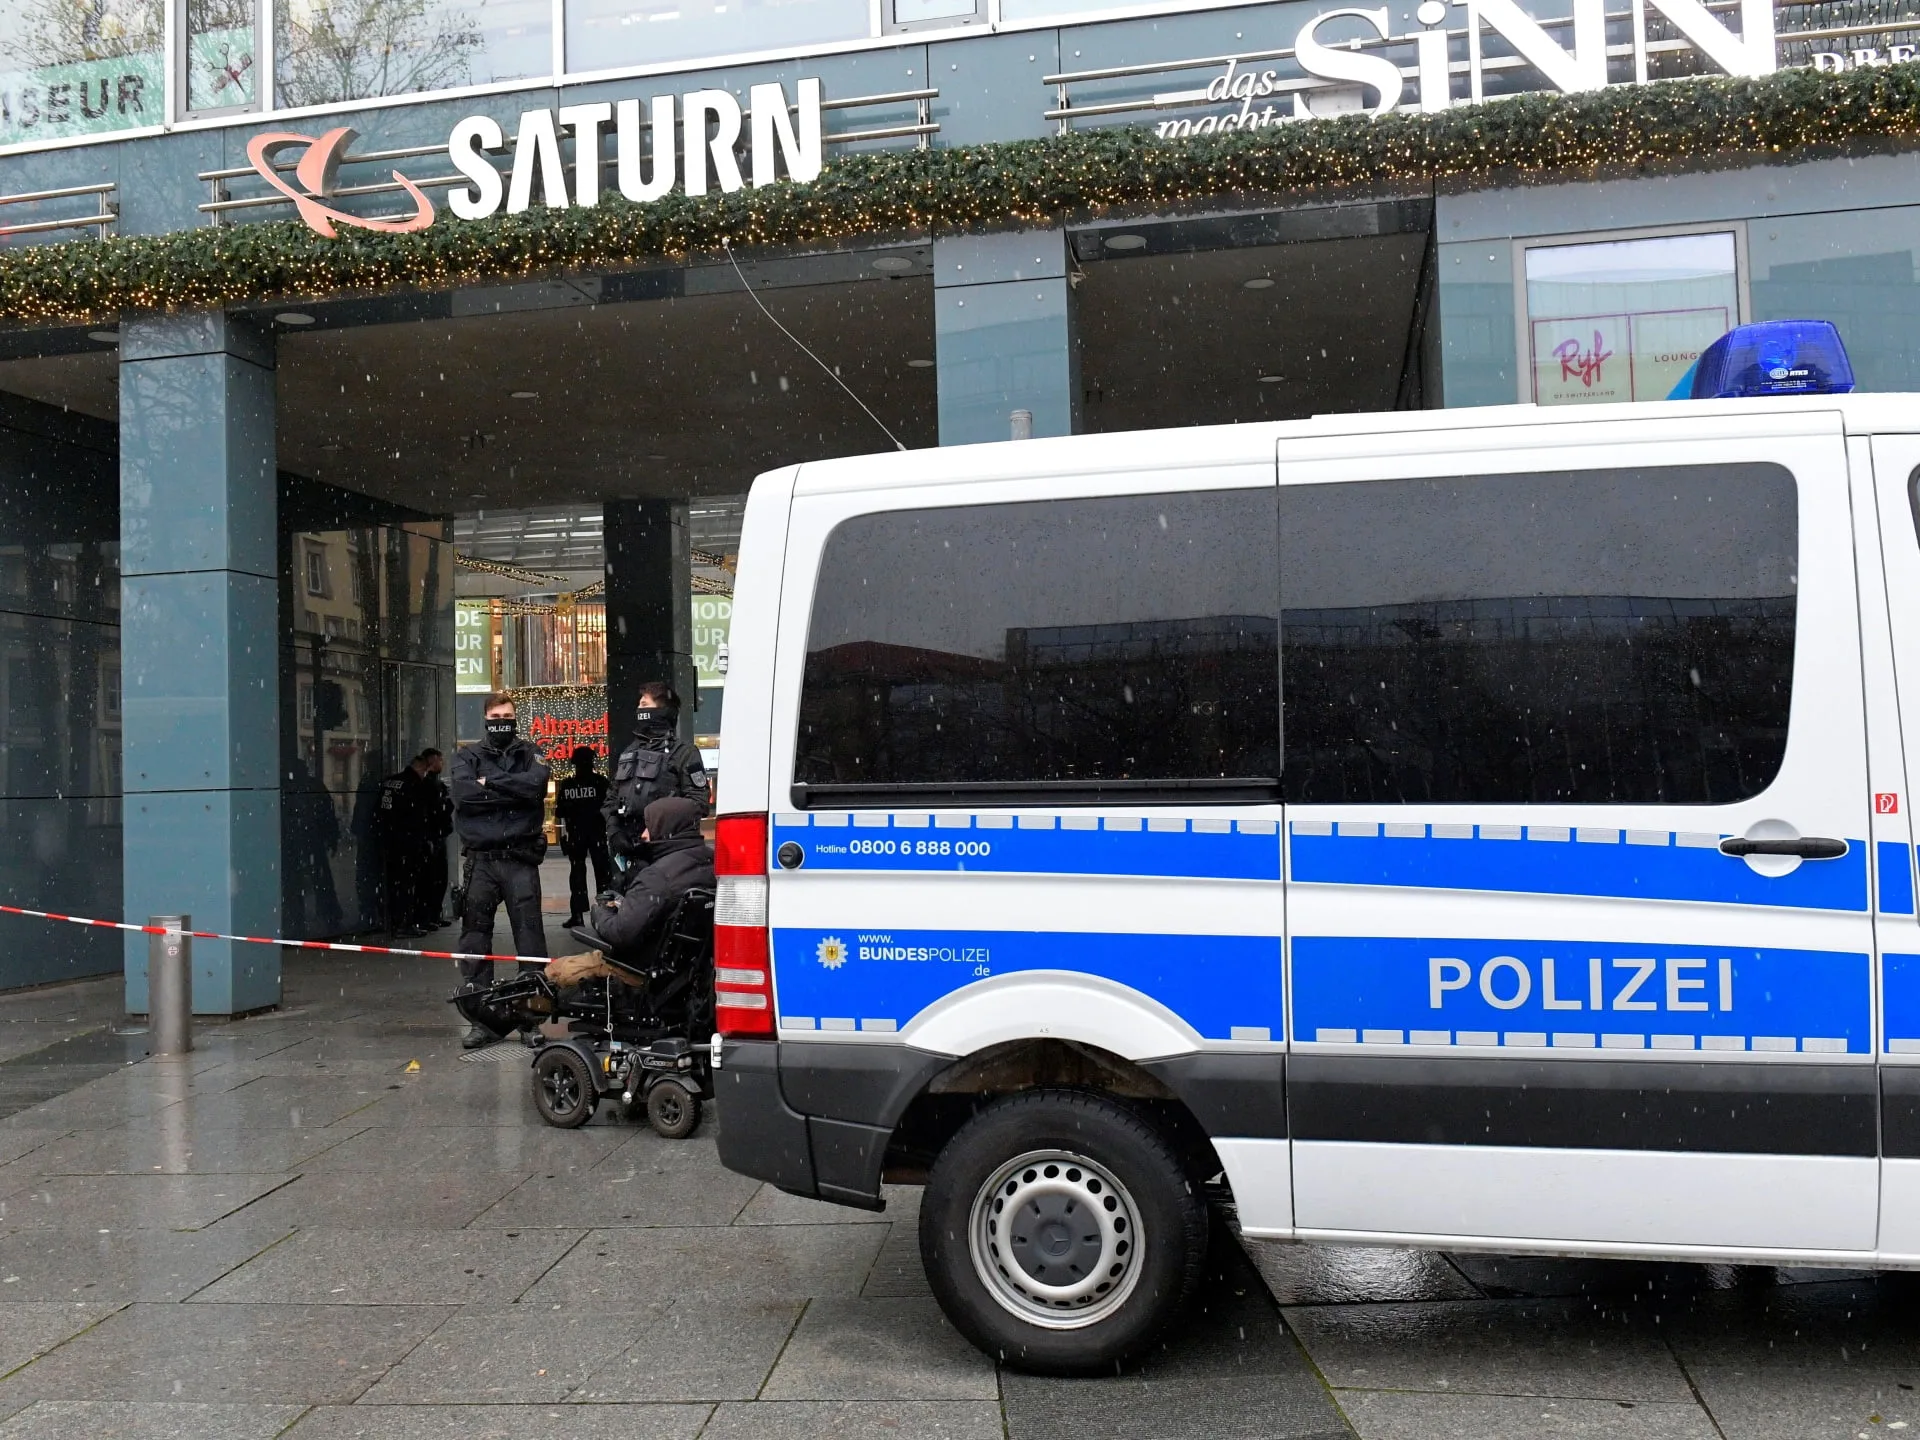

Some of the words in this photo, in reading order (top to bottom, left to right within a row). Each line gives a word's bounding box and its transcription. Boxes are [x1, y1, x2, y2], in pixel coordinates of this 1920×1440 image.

[1206, 59, 1277, 101] das
[448, 77, 822, 220] SATURN
[1654, 352, 1703, 363] LOUNG
[564, 786, 597, 800] POLIZEI
[815, 843, 847, 854] Hotline
[849, 839, 896, 855] 0800
[900, 841, 912, 855] 6
[915, 840, 951, 855] 888
[954, 841, 991, 857] 000
[857, 934, 894, 944] www.
[859, 946, 990, 963] BUNDESPOLIZEI
[971, 964, 990, 977] .de
[1428, 955, 1733, 1012] POLIZEI
